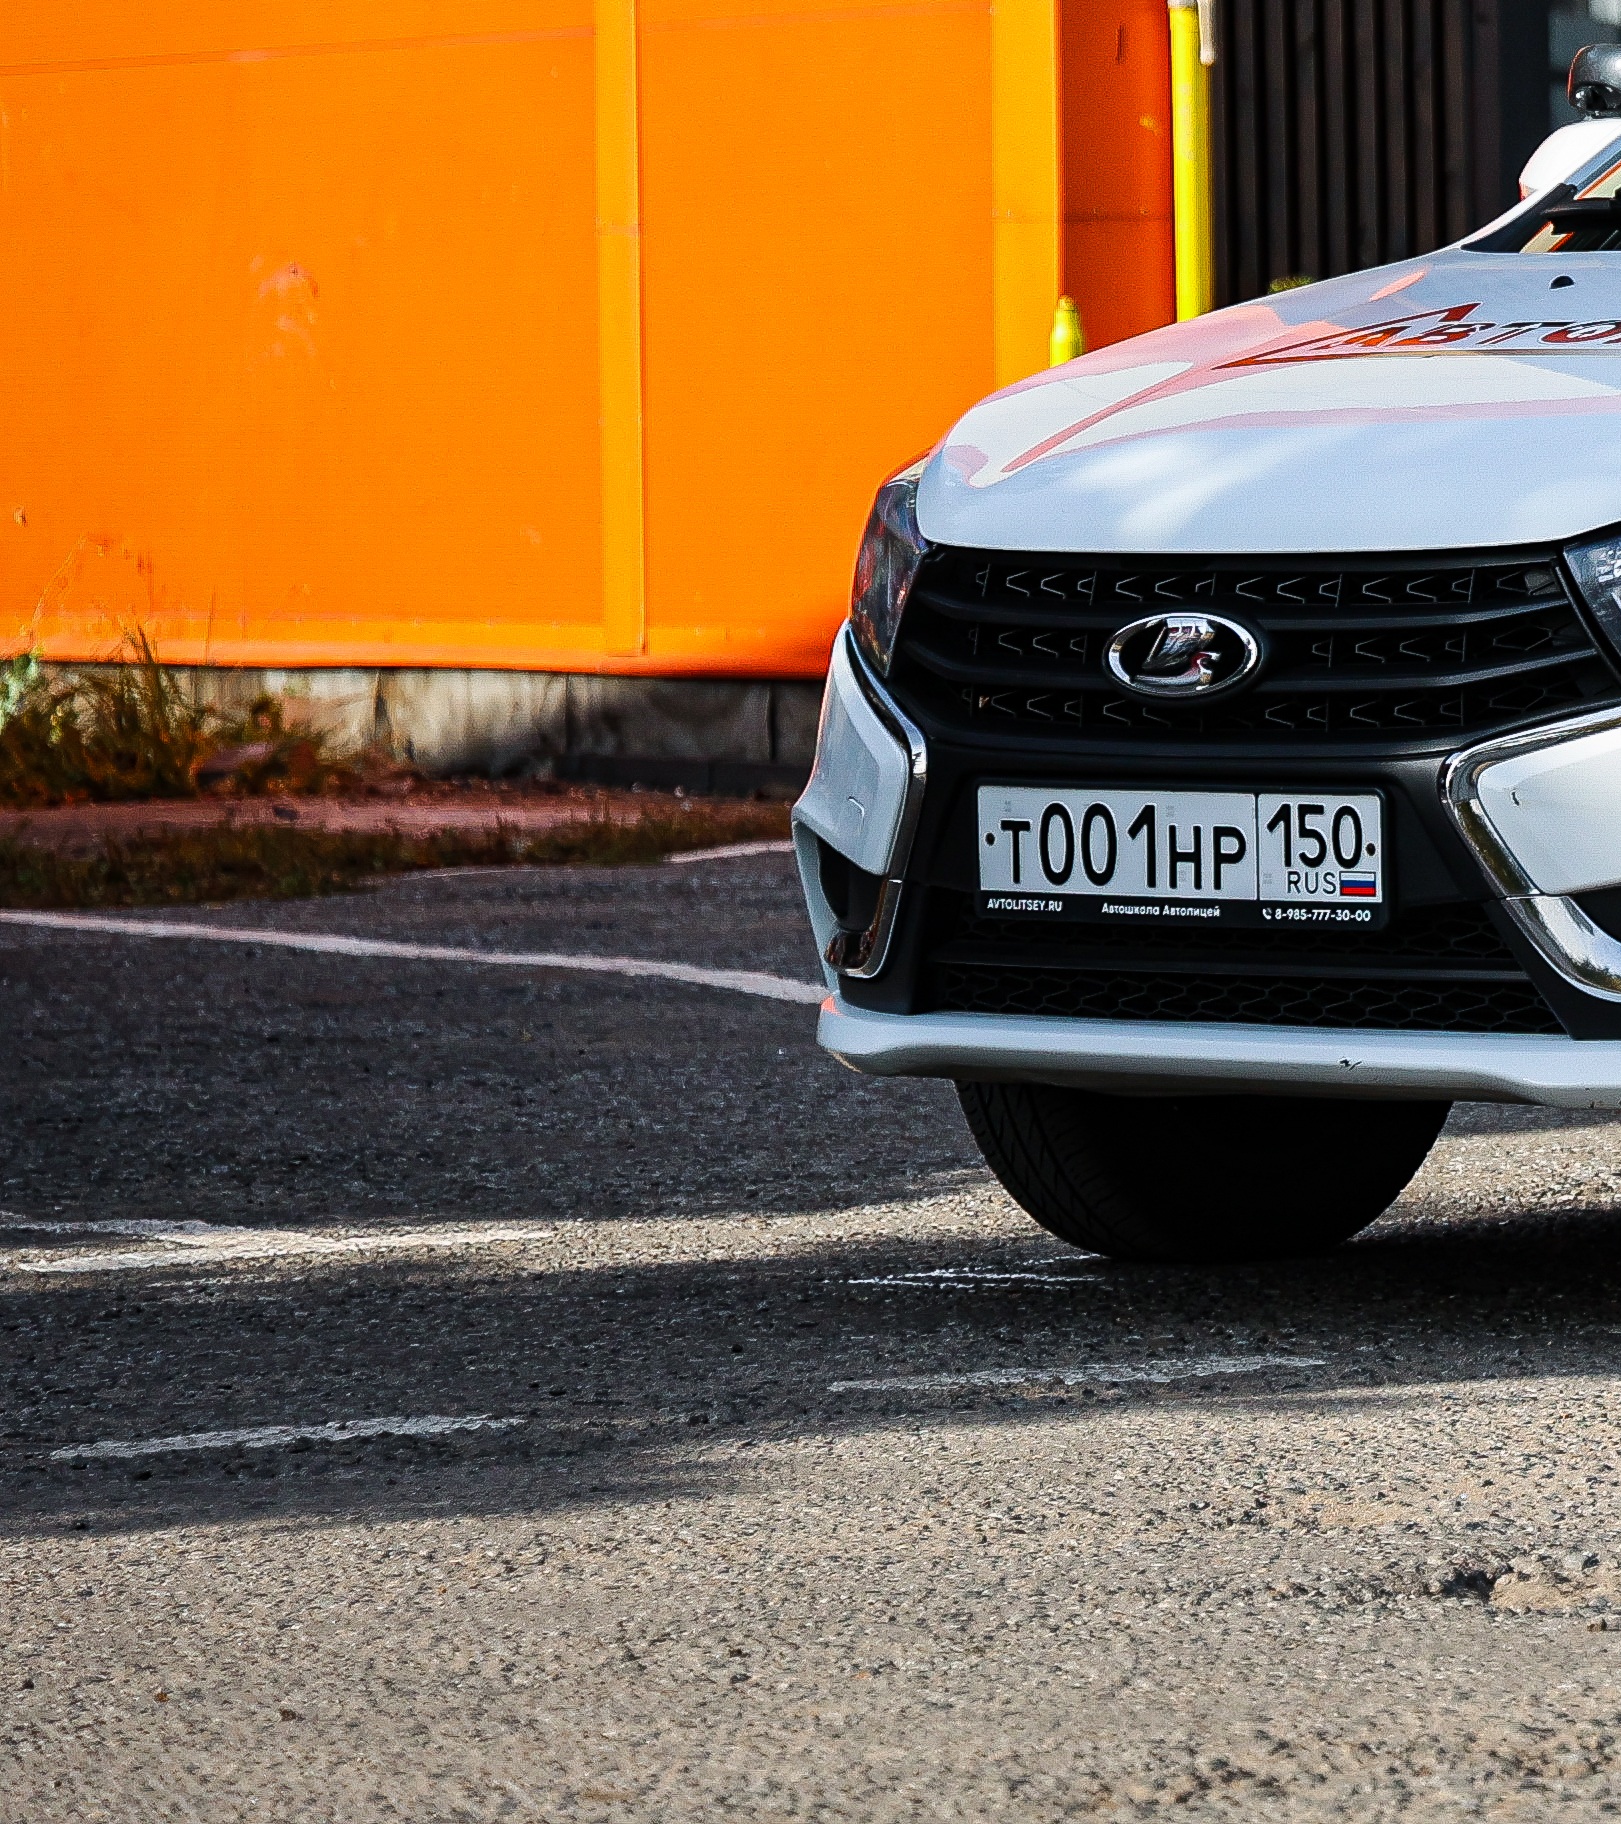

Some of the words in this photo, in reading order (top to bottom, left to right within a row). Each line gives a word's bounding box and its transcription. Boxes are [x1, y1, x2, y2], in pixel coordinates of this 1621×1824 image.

[1265, 802, 1364, 870] 150
[1286, 870, 1337, 895] RUS
[986, 897, 1064, 913] AVTOLITSEY.RU
[1101, 901, 1160, 917] Автошкола
[1162, 902, 1222, 920] Автолицей
[1274, 907, 1372, 923] 8-985-777-30-00
